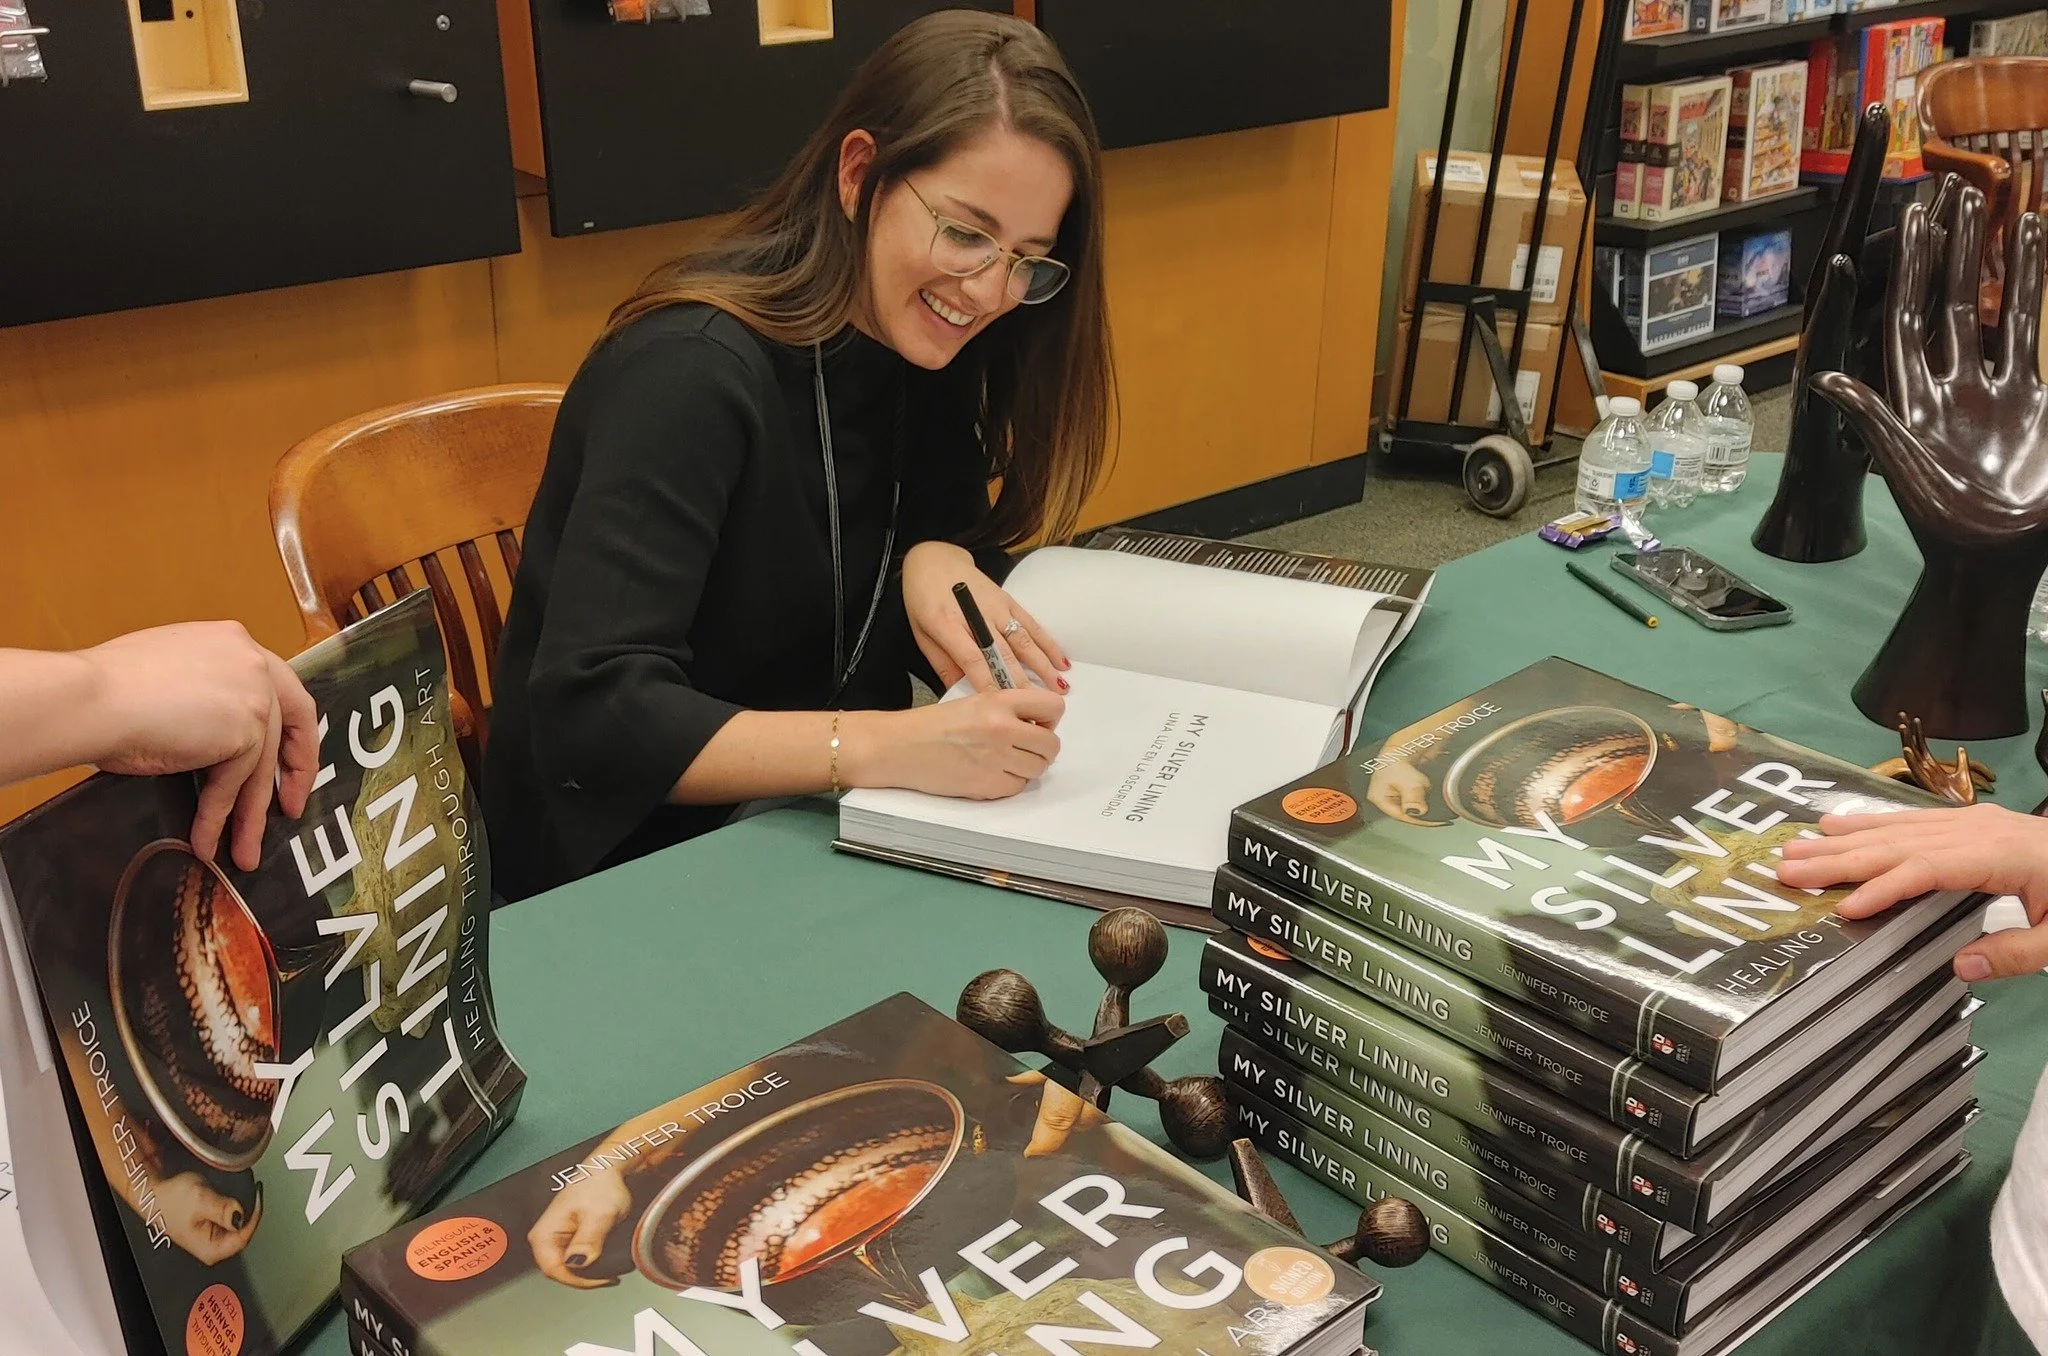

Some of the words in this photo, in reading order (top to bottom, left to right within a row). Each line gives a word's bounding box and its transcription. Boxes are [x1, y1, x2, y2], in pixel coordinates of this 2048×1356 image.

[414, 666, 435, 726] ART
[1161, 712, 1180, 732] UNA
[1151, 735, 1168, 749] LUZ
[1187, 714, 1209, 737] MY
[1360, 733, 1442, 774] JENNIFER
[1435, 702, 1502, 735] TROICE
[1136, 762, 1148, 772] LA
[1142, 751, 1157, 761] EN
[1155, 741, 1195, 780] SILVER
[1101, 774, 1140, 817] OSCURIDAD
[1125, 783, 1167, 822] LINING
[1296, 796, 1333, 816] ENGLISH
[1310, 799, 1347, 818] SPANISH
[1328, 808, 1348, 818] TEXT
[425, 743, 477, 906] THROUGH
[1440, 810, 1589, 890] MY
[1531, 761, 1837, 930] SILVER
[347, 684, 463, 1103] LINING
[1244, 837, 1279, 867] MY
[1287, 859, 1373, 915] SILVER
[1382, 903, 1473, 961] LINING
[1497, 962, 1558, 999] JENNIFER
[1561, 991, 1610, 1024] TROICE
[459, 914, 485, 1050] HEALING
[1227, 892, 1262, 923] MY
[1269, 913, 1353, 972] SILVER
[1362, 960, 1451, 1021] LINING
[1473, 1023, 1533, 1061] JENNIFER
[1535, 1052, 1584, 1086] TROICE
[1717, 930, 1824, 995] HEALING
[72, 1001, 120, 1117] TROICE
[1216, 968, 1252, 999] MY
[1260, 991, 1348, 1049] SILVER
[1358, 1038, 1450, 1098] LINING
[1474, 1101, 1536, 1138] JENNIFER
[1539, 1131, 1588, 1164] TROICE
[254, 1046, 356, 1226] MY
[550, 1121, 687, 1192] JENNIFER
[684, 1072, 790, 1124] TROICE
[1234, 1053, 1268, 1084] MY
[1274, 1078, 1354, 1138] SILVER
[1364, 1128, 1449, 1190] LINING
[1471, 1196, 1529, 1232] JENNIFER
[1532, 1227, 1578, 1262] TROICE
[1349, 1067, 1432, 1129] LINING
[1452, 1134, 1510, 1172] JENNIFER
[1512, 1166, 1558, 1200] TROICE
[112, 1115, 170, 1250] JENNIFER
[1239, 1104, 1270, 1136] MY
[1278, 1130, 1357, 1190] SILVER
[1471, 1250, 1528, 1290] JENNIFER
[1531, 1284, 1576, 1318] TROICE
[414, 1222, 478, 1256] BILINGUAL
[418, 1232, 481, 1268] ENGLISH
[482, 1227, 494, 1235] &
[434, 1237, 496, 1271] SPANISH
[458, 1253, 490, 1272] TEXT
[207, 1295, 237, 1343] SPANISH
[222, 1296, 238, 1321] TEXT
[355, 1299, 383, 1341] MY
